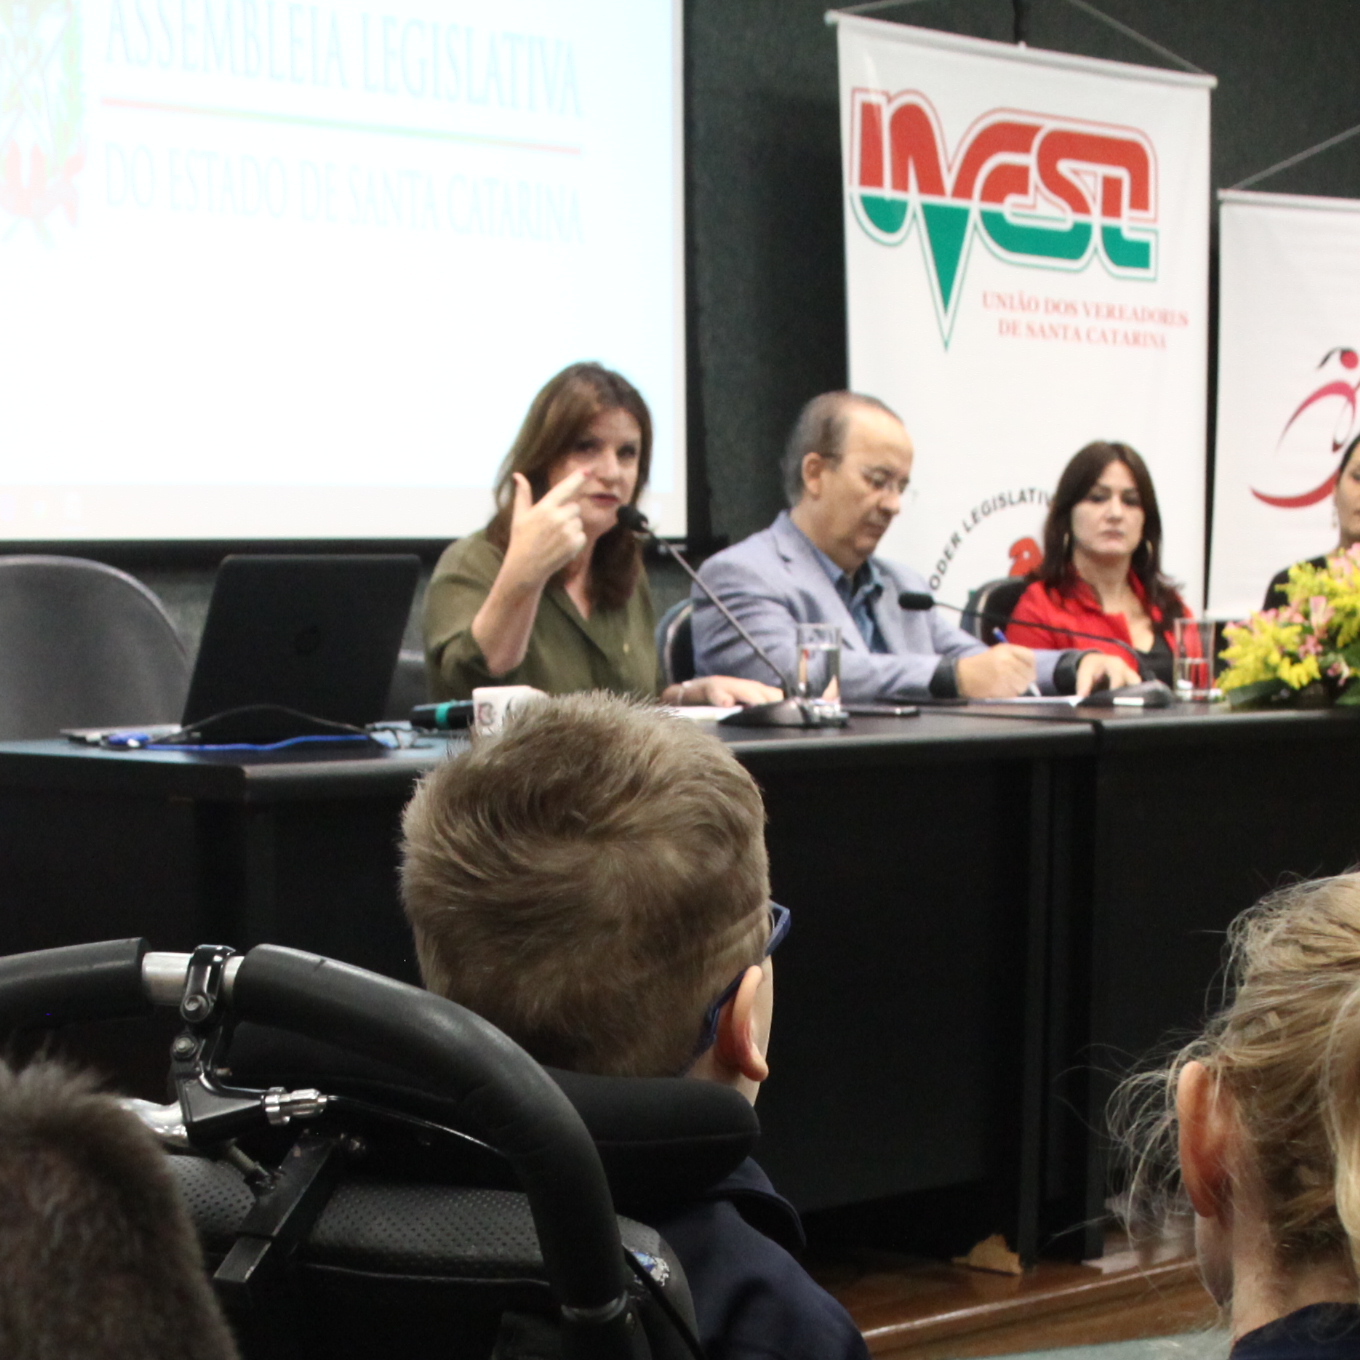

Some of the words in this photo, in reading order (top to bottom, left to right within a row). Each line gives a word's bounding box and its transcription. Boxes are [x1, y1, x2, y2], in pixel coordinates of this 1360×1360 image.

[362, 12, 583, 118] LEGISLATIVA
[104, 143, 157, 208] DO
[170, 149, 288, 219] ESTADO
[301, 161, 337, 223] DE
[350, 166, 437, 231] SANTA
[447, 174, 585, 243] CATARINA
[983, 290, 1040, 314] UNIÃO
[1044, 297, 1078, 317] DOS
[1082, 300, 1189, 327] VEREADORES
[998, 318, 1020, 337] DE
[1026, 322, 1082, 343] SANTA
[929, 532, 962, 591] ODER
[962, 488, 1052, 533] LEGISLATIV
